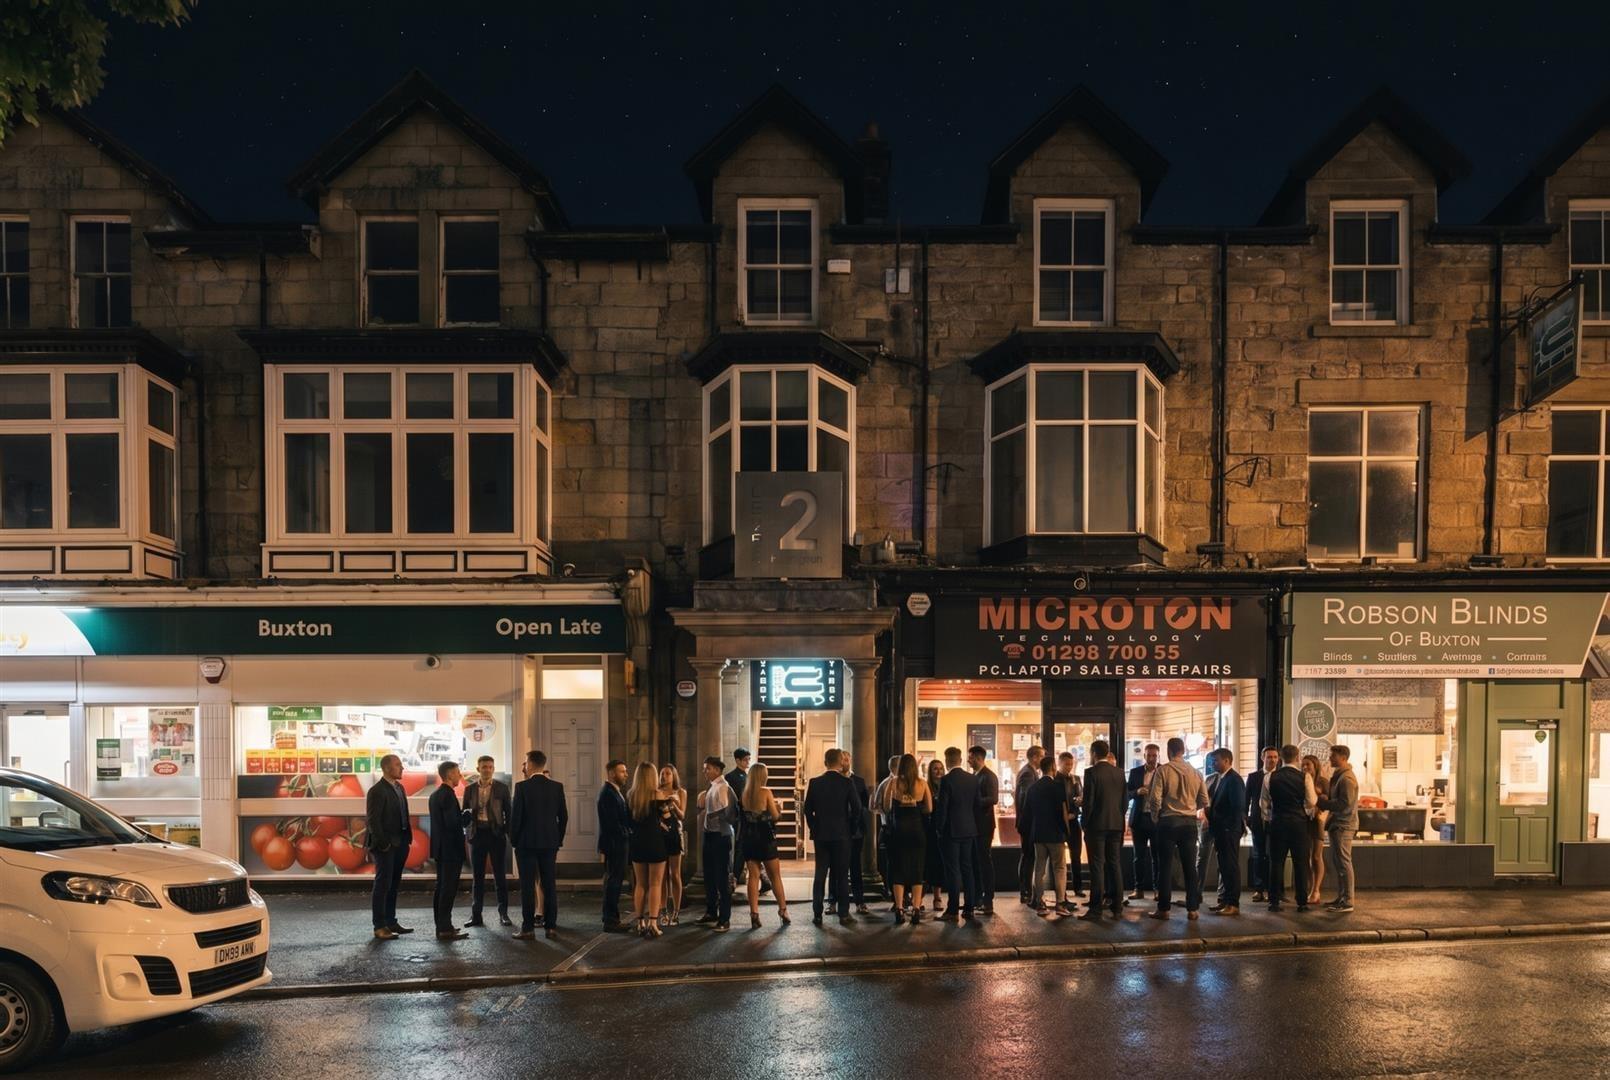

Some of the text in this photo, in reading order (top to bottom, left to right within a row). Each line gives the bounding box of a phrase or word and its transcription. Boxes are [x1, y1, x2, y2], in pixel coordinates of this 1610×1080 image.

[780, 489, 818, 550] 2
[978, 597, 1232, 630] MICROTON
[1323, 598, 1548, 625] ROBSON BLINDS
[258, 619, 332, 636] Buxton
[495, 617, 602, 640] Open Late
[998, 634, 1202, 642] TECHNOLOGY
[1032, 644, 1099, 661] 01298
[1107, 645, 1147, 661] 700
[1154, 645, 1180, 661] 55
[1323, 652, 1353, 662] Blinds
[979, 665, 1232, 675] PC.LAPTOP SALES & REPAIRS
